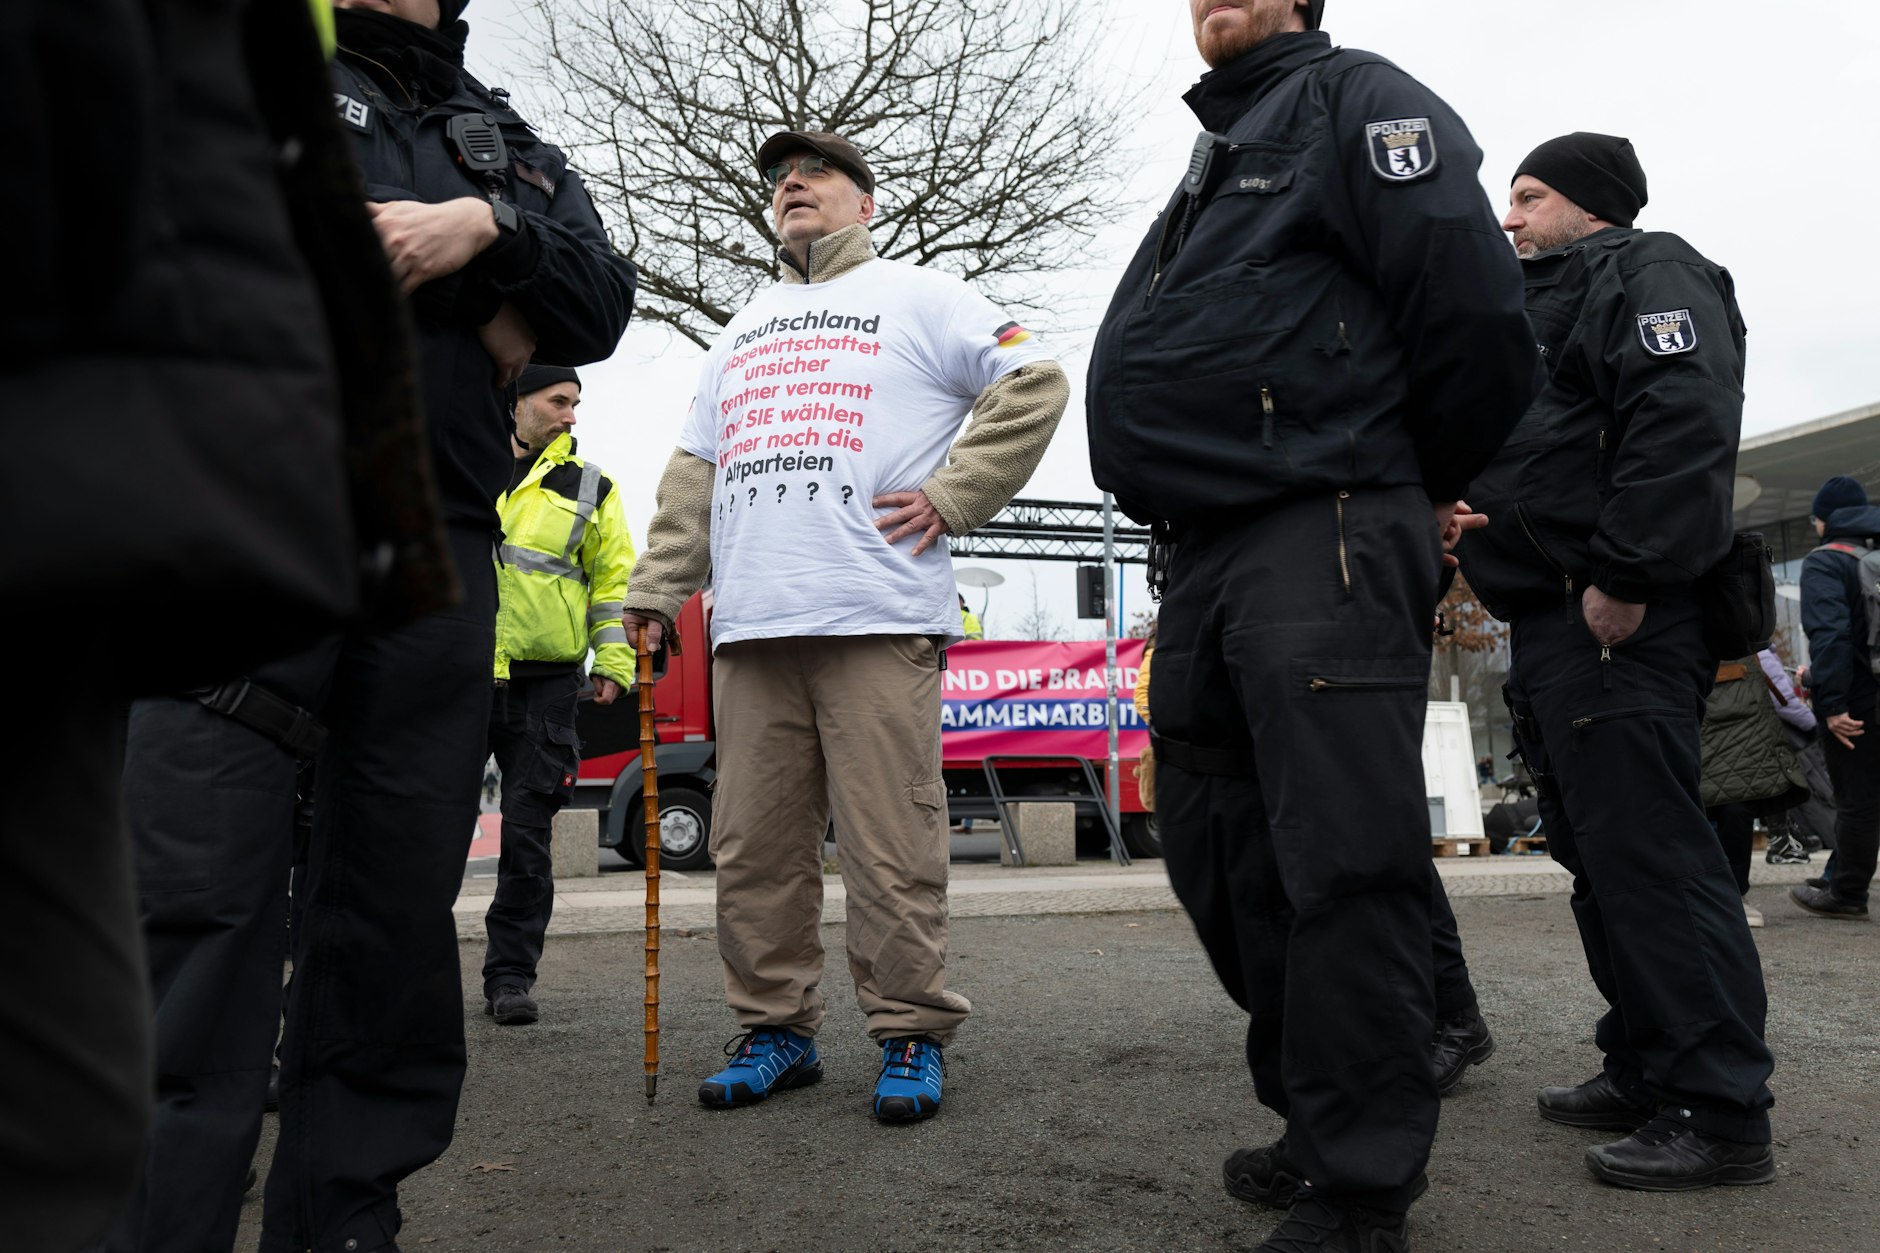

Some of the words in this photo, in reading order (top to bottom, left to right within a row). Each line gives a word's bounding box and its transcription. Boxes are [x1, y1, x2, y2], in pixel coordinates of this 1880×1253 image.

[1371, 121, 1427, 137] POLIZEI
[734, 309, 881, 350] Deutschland
[1641, 312, 1687, 326] POLIZEI
[744, 355, 830, 382] unsicher
[721, 383, 780, 419] Rentner
[786, 381, 873, 400] verarmt
[746, 407, 775, 428] SIE
[781, 402, 864, 427] wählen
[767, 426, 820, 449] noch
[827, 428, 864, 453] die
[725, 450, 833, 487] Altparteien
[748, 487, 758, 507] ?
[776, 483, 787, 504] ?
[807, 481, 820, 502] ?
[841, 485, 854, 505] ?
[996, 668, 1043, 691] DIE
